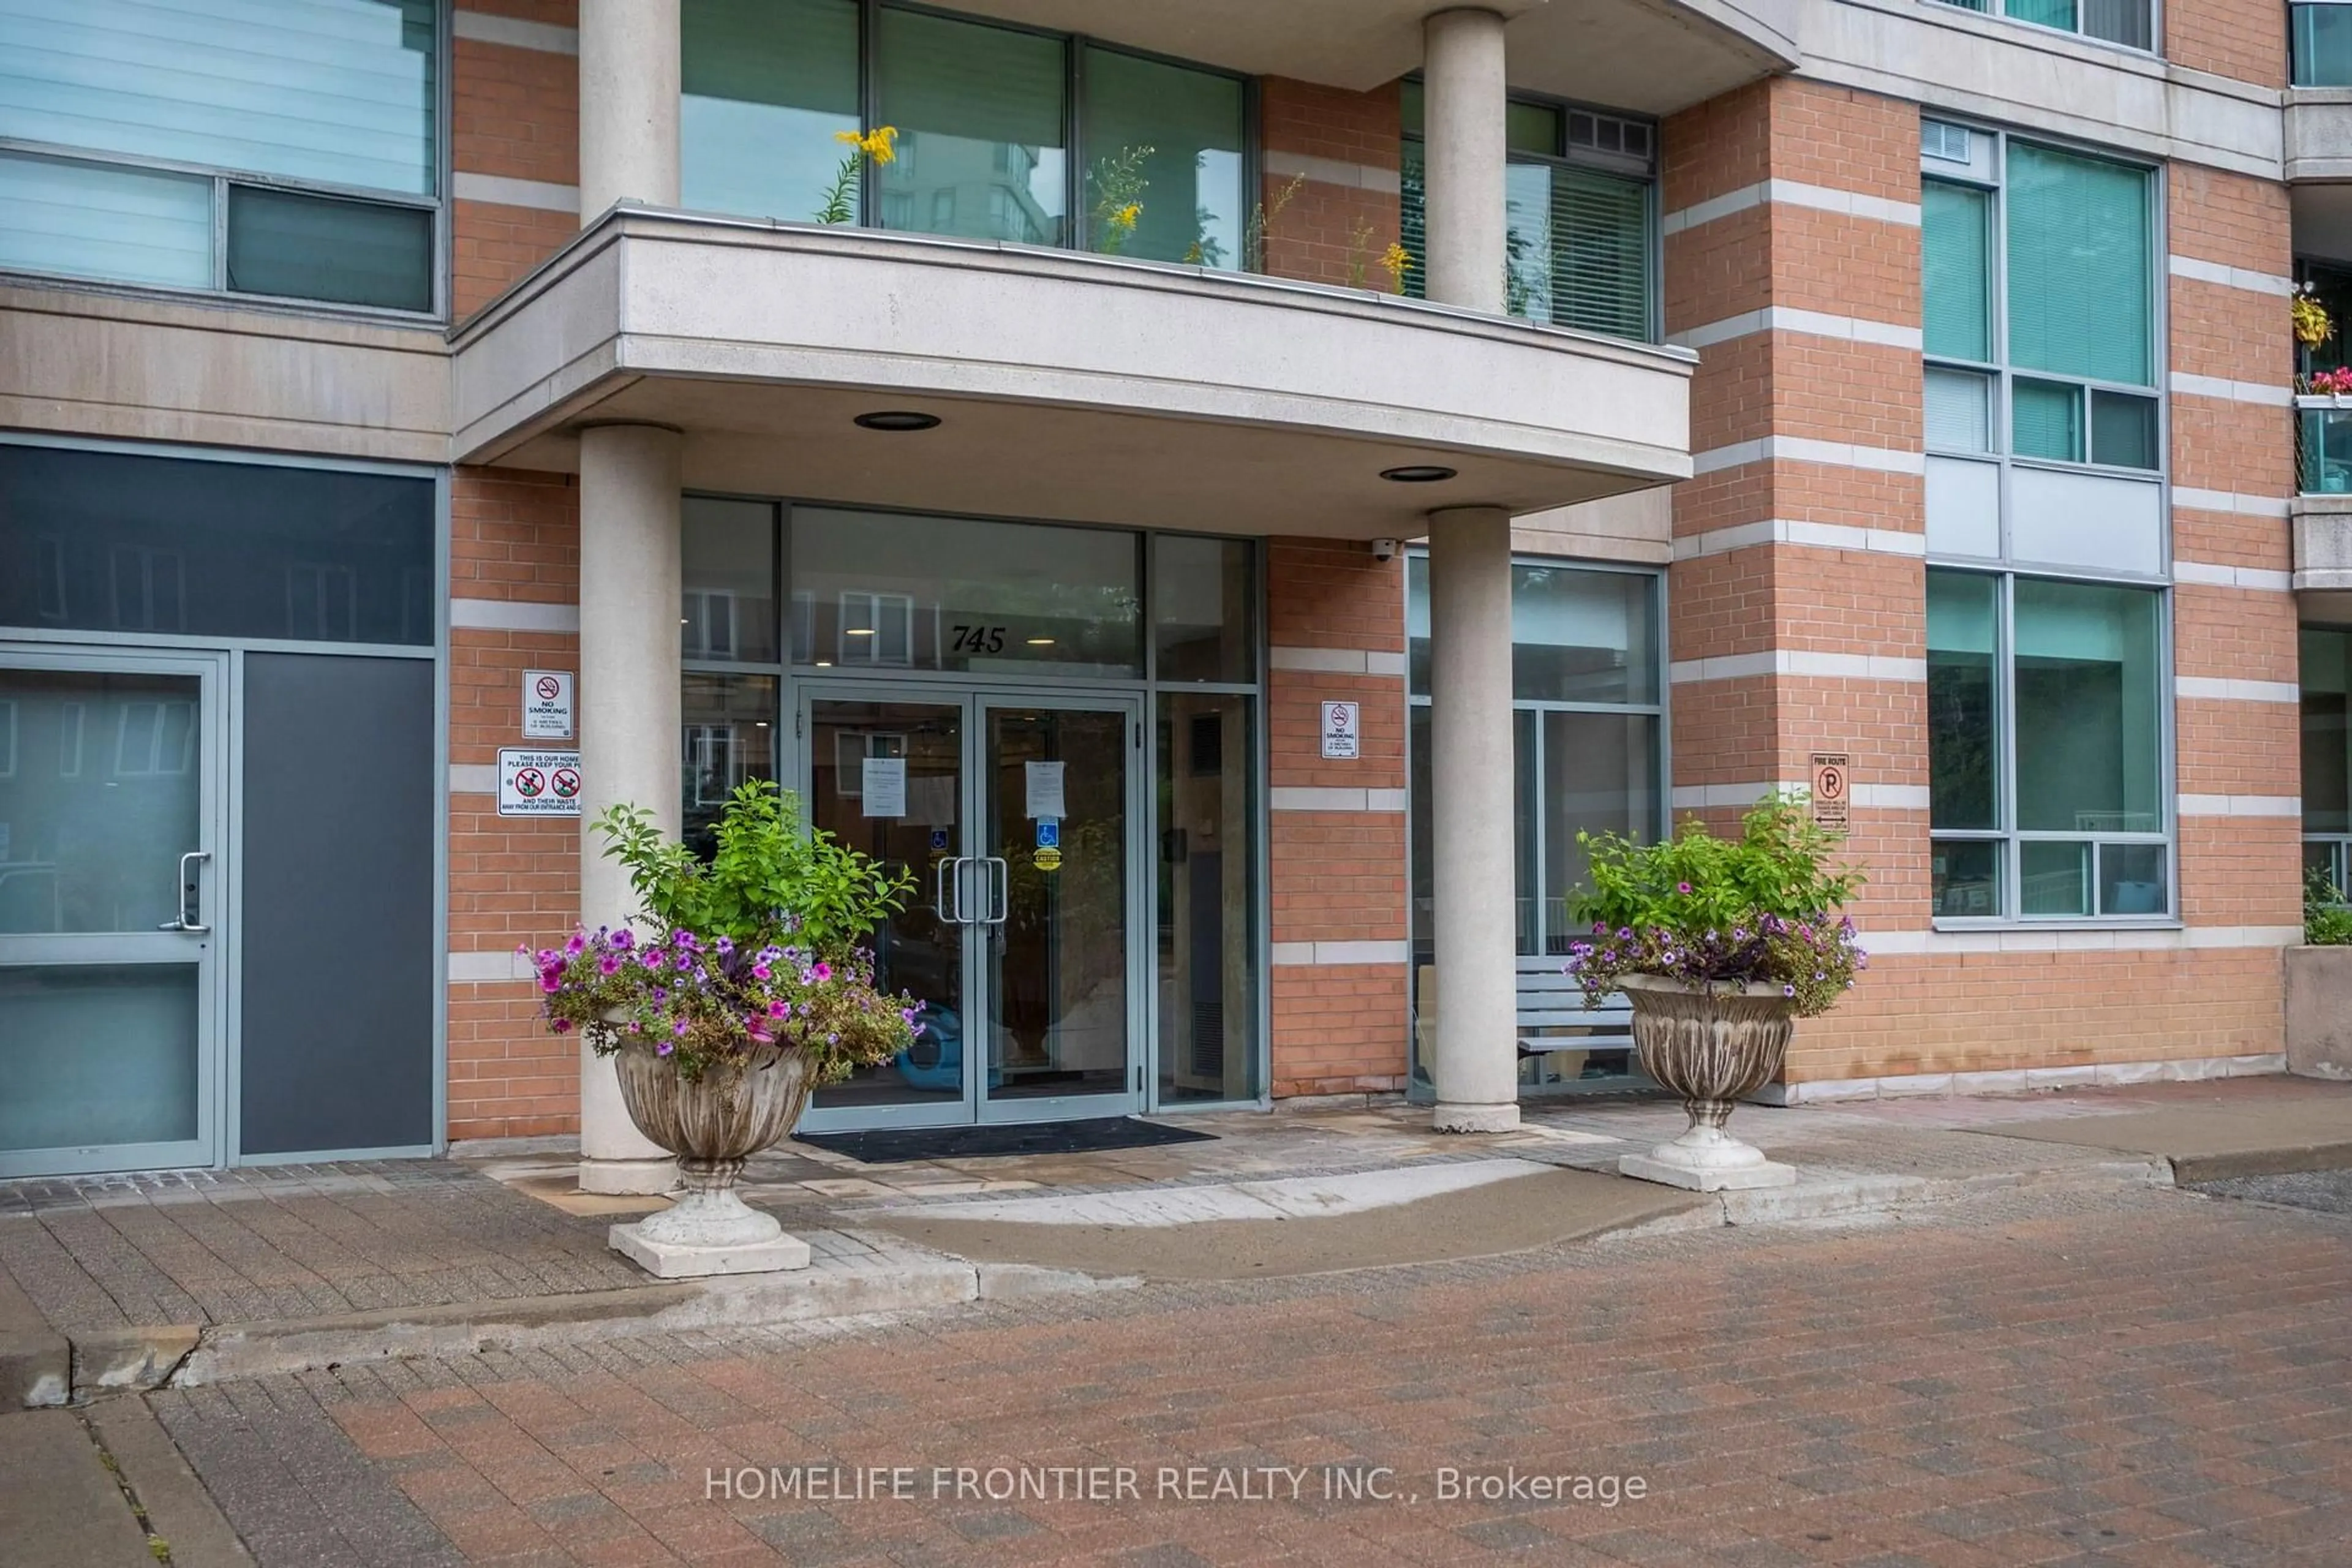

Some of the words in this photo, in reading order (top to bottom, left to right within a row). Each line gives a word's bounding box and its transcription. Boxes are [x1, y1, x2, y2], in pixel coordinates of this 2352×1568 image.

[952, 625, 1006, 654] 745
[1814, 756, 1827, 766] FIRE
[1828, 758, 1846, 766] ROUTE
